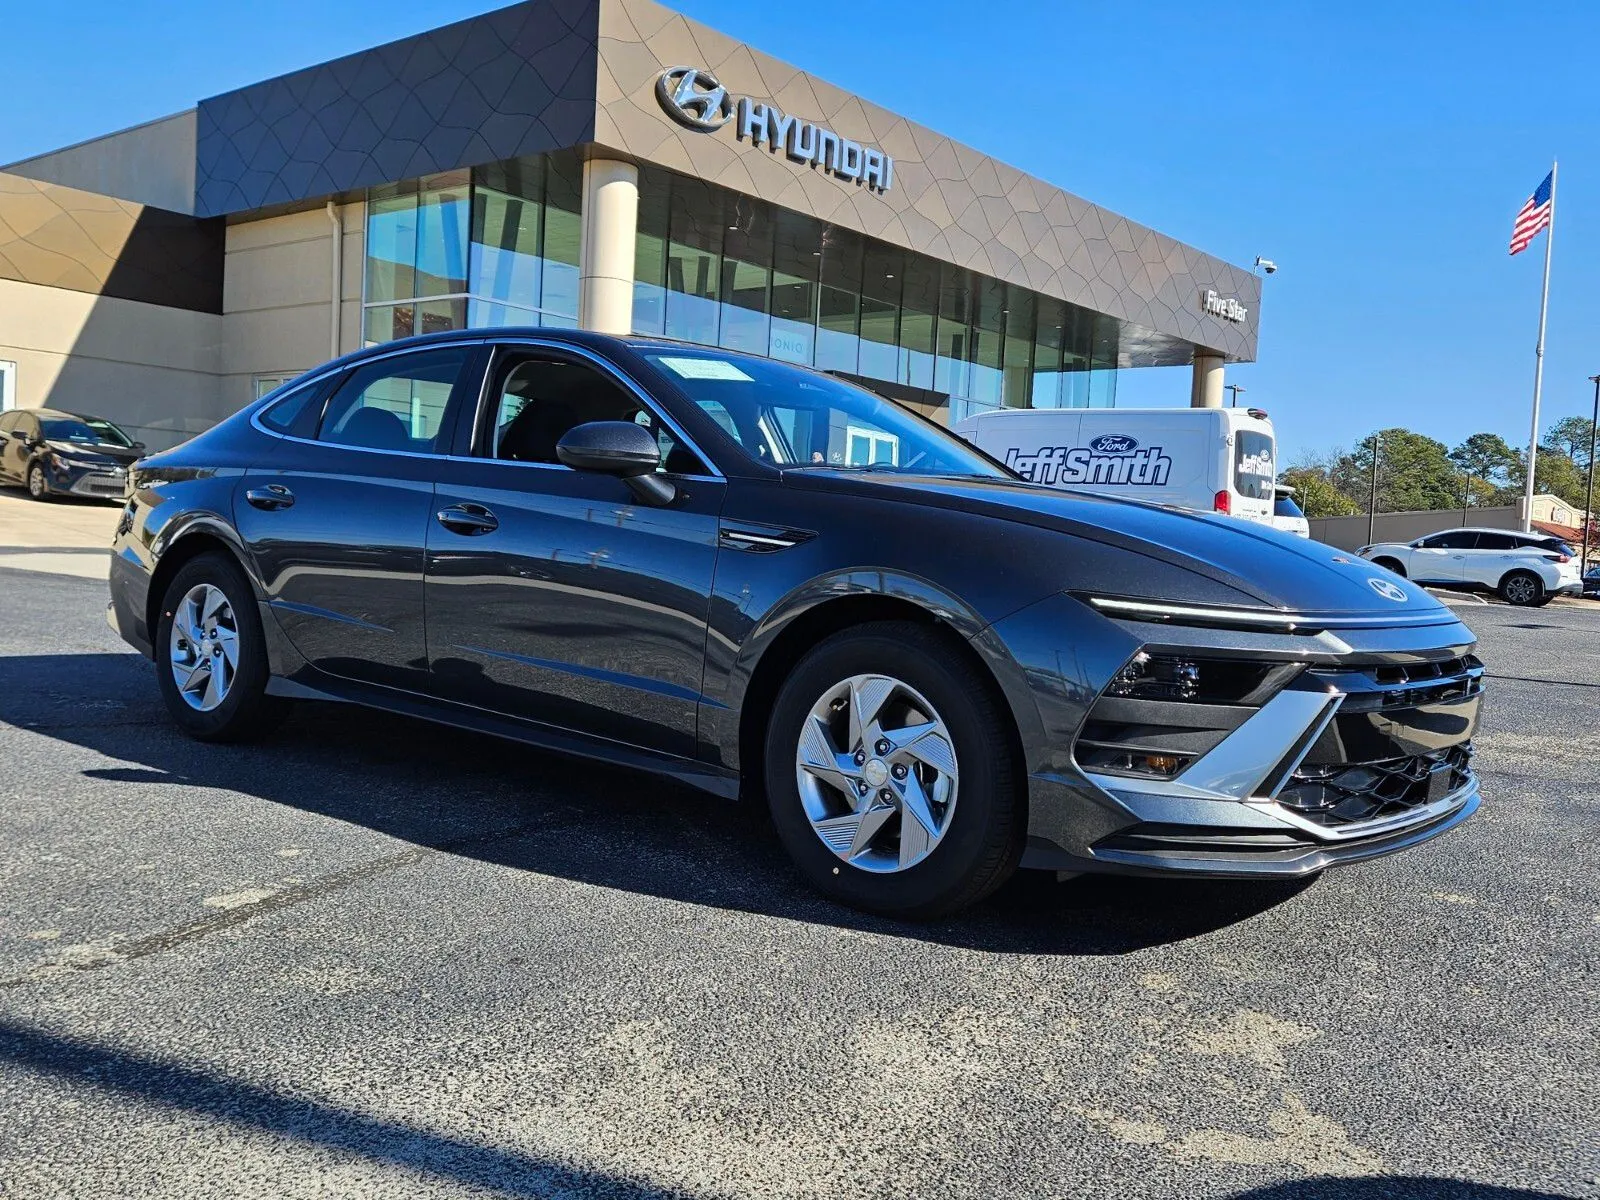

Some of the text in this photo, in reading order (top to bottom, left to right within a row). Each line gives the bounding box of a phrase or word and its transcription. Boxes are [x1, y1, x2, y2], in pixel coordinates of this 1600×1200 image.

[738, 96, 894, 192] HYUNDAI
[1206, 289, 1248, 322] Five Star
[1097, 437, 1130, 450] Ford
